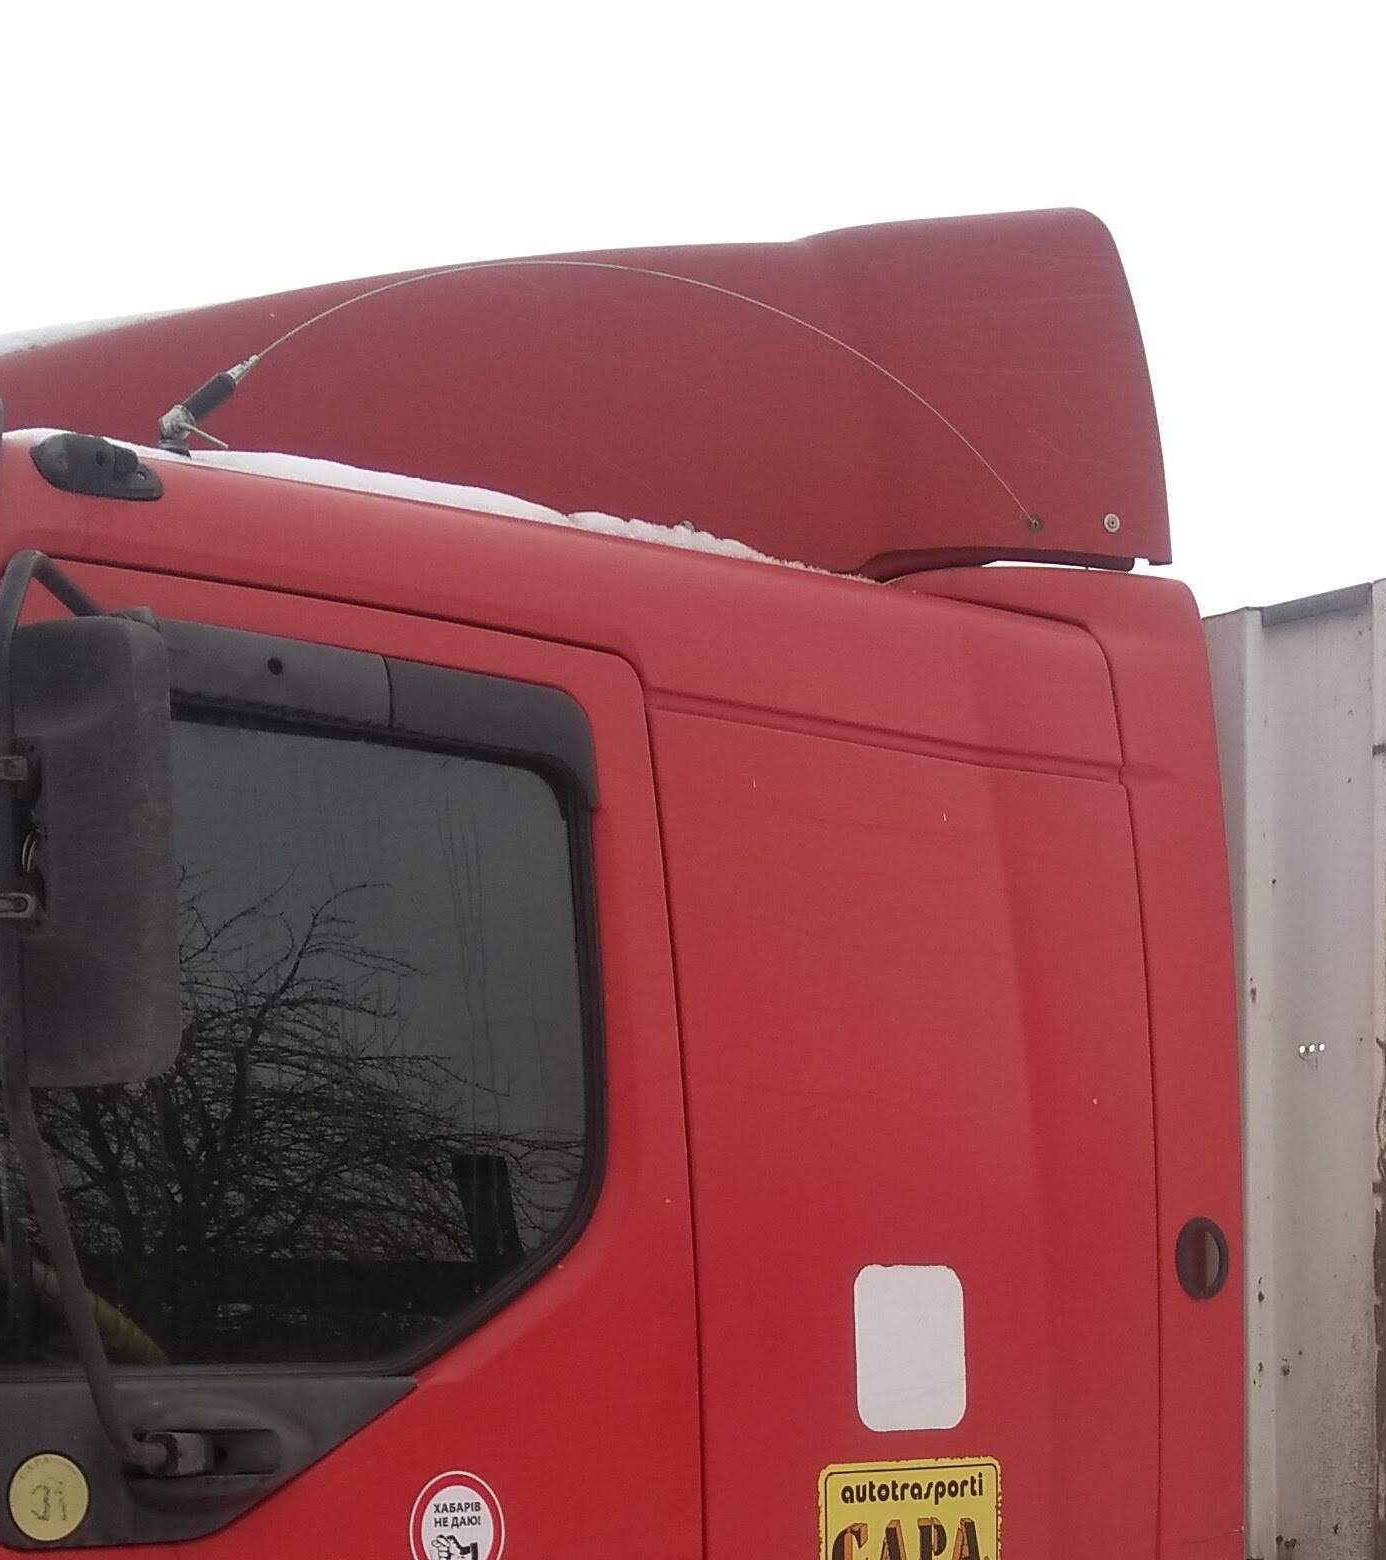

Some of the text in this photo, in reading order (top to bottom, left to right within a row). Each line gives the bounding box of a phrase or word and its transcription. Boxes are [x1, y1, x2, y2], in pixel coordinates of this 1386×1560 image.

[841, 1472, 983, 1505] autotrasporti
[433, 1502, 481, 1513] ХАБАРІВ
[434, 1516, 481, 1528] НЕ ДАЮ!
